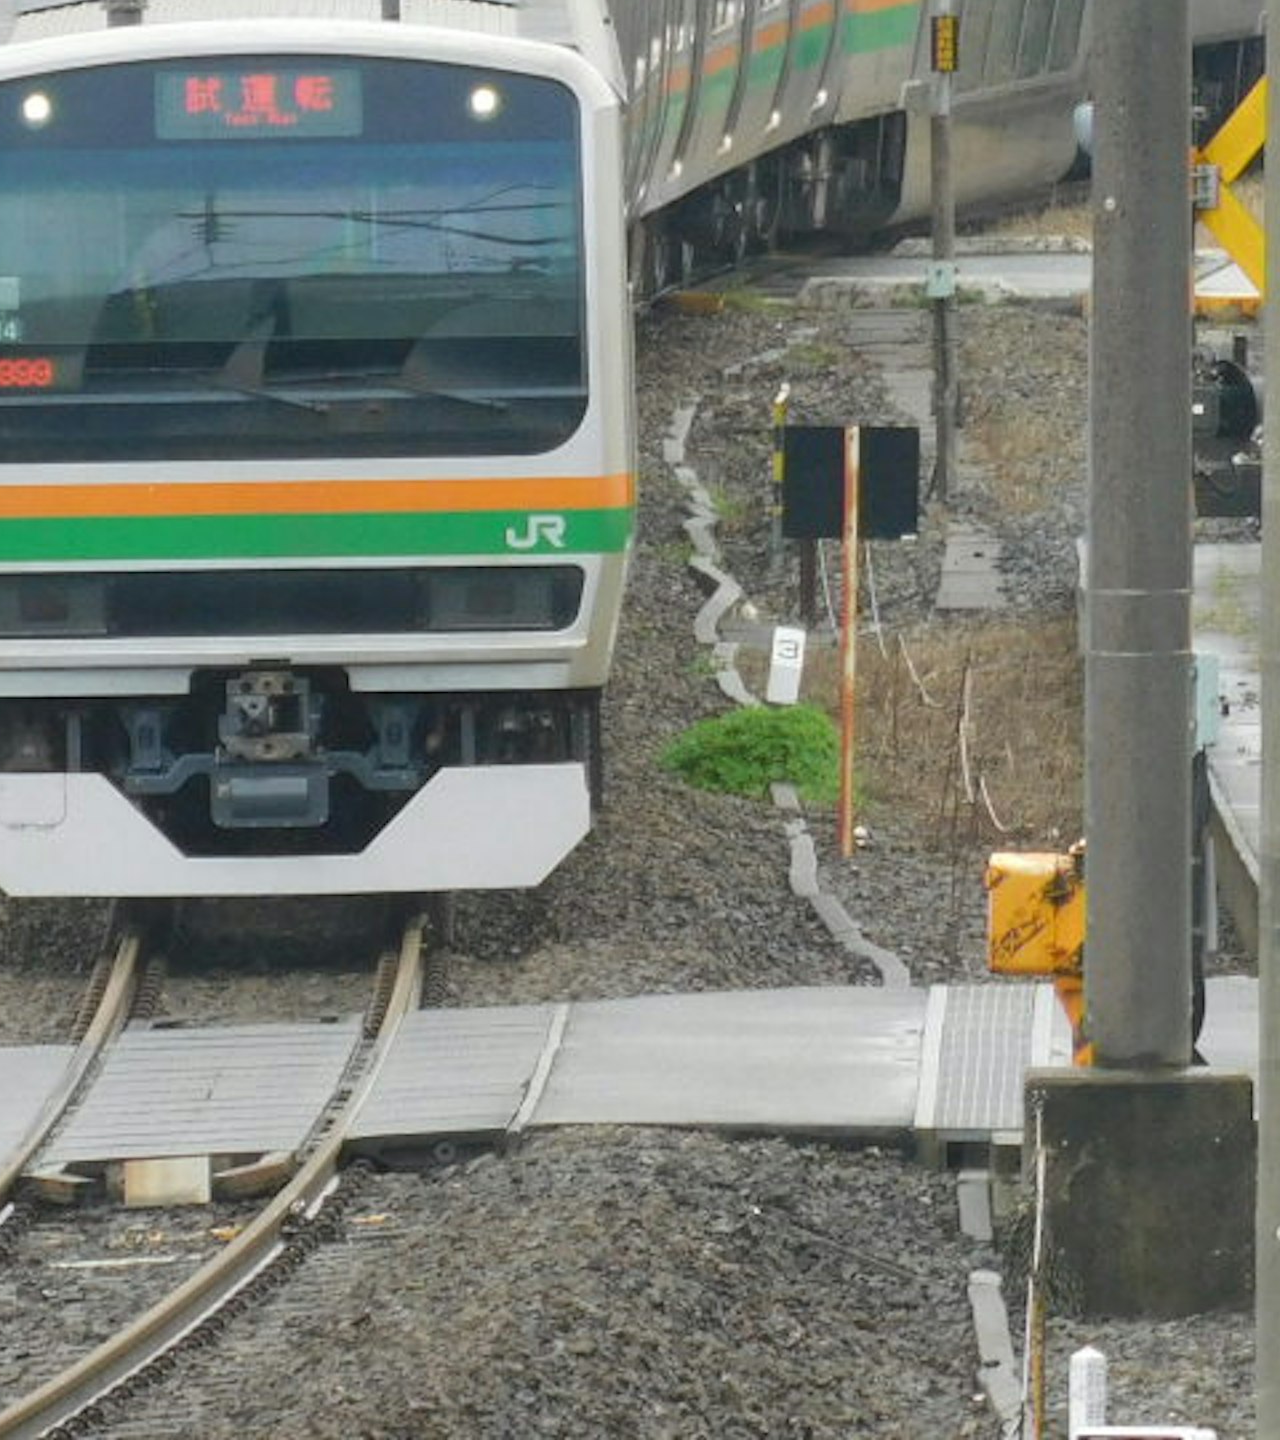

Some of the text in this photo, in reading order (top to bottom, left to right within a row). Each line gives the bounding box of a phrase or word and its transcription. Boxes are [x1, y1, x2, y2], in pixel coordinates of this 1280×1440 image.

[185, 73, 334, 115] 試運転
[505, 514, 567, 549] JR
